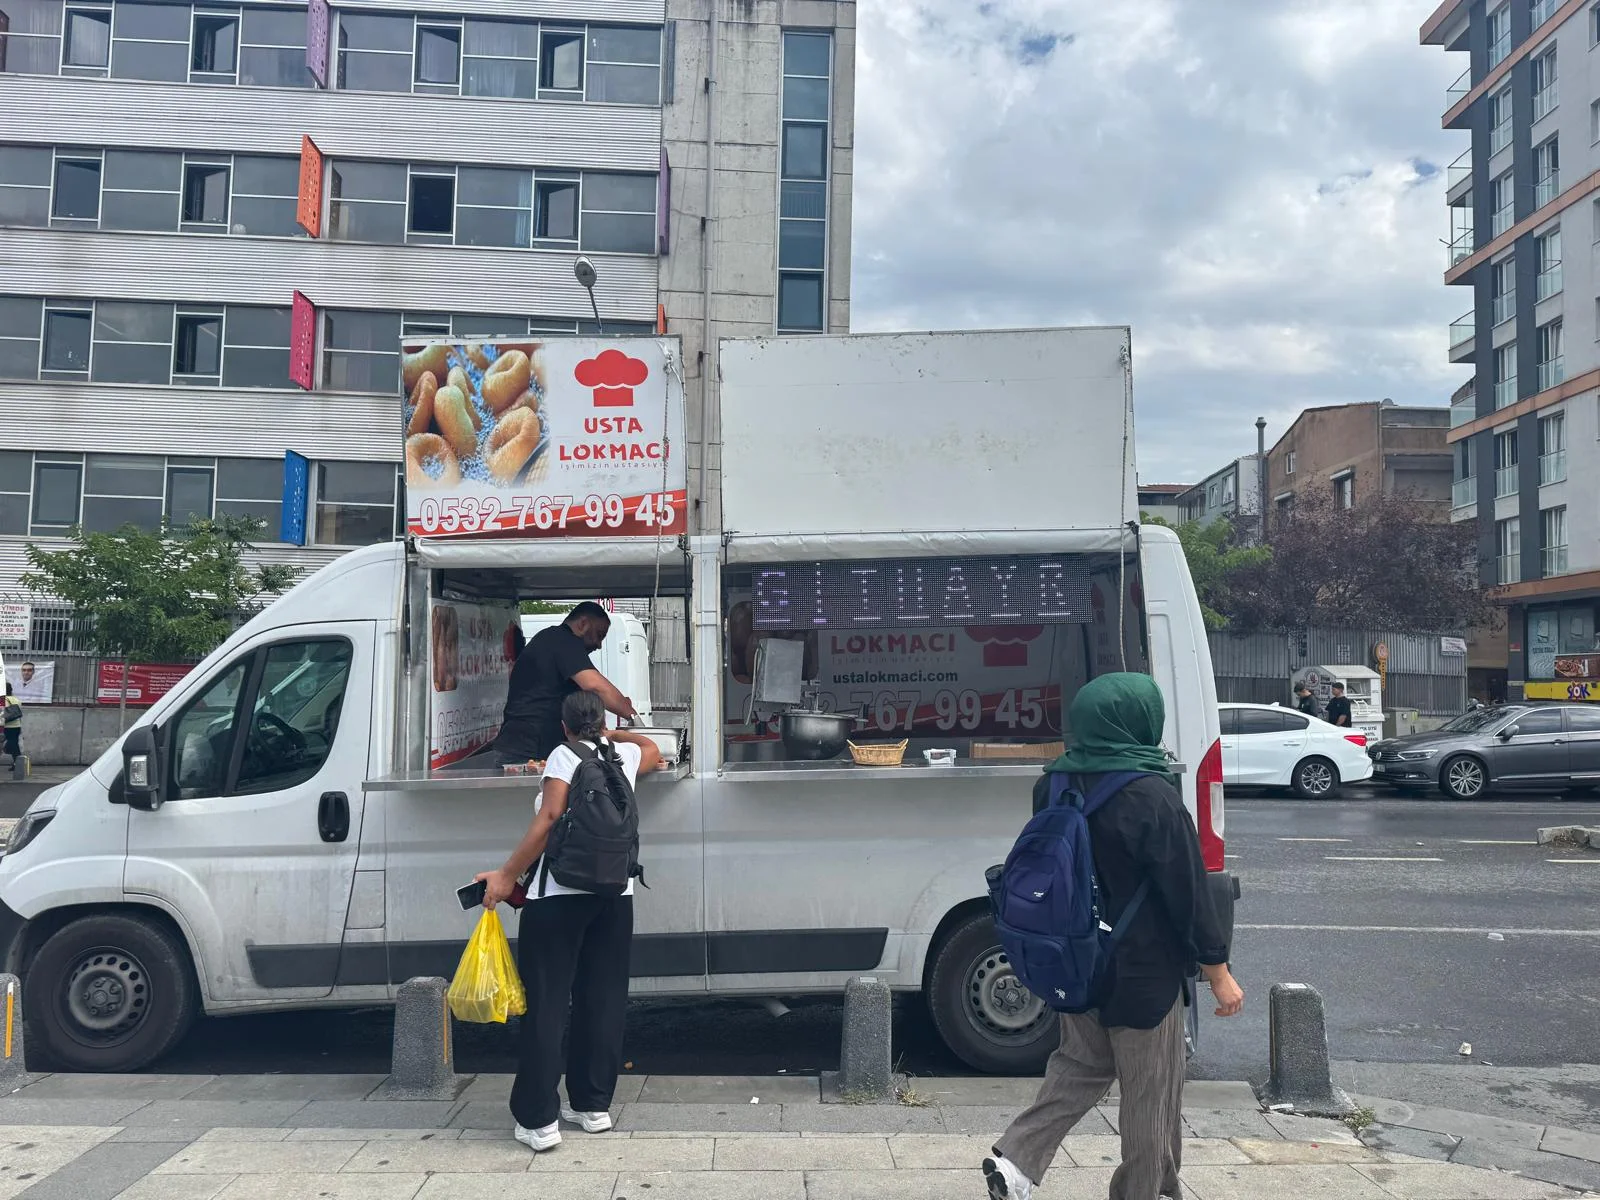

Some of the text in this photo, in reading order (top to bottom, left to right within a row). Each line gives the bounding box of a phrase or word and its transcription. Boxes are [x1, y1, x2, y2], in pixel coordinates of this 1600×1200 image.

[584, 416, 643, 434] USTA
[559, 442, 669, 461] LOKMACI
[420, 493, 675, 532] 0532 767 99 45
[831, 632, 955, 655] LOKMACI
[833, 670, 958, 684] ustalokmaci.com
[850, 689, 922, 732] 767
[935, 687, 982, 731] 99
[994, 687, 1043, 729] 45
